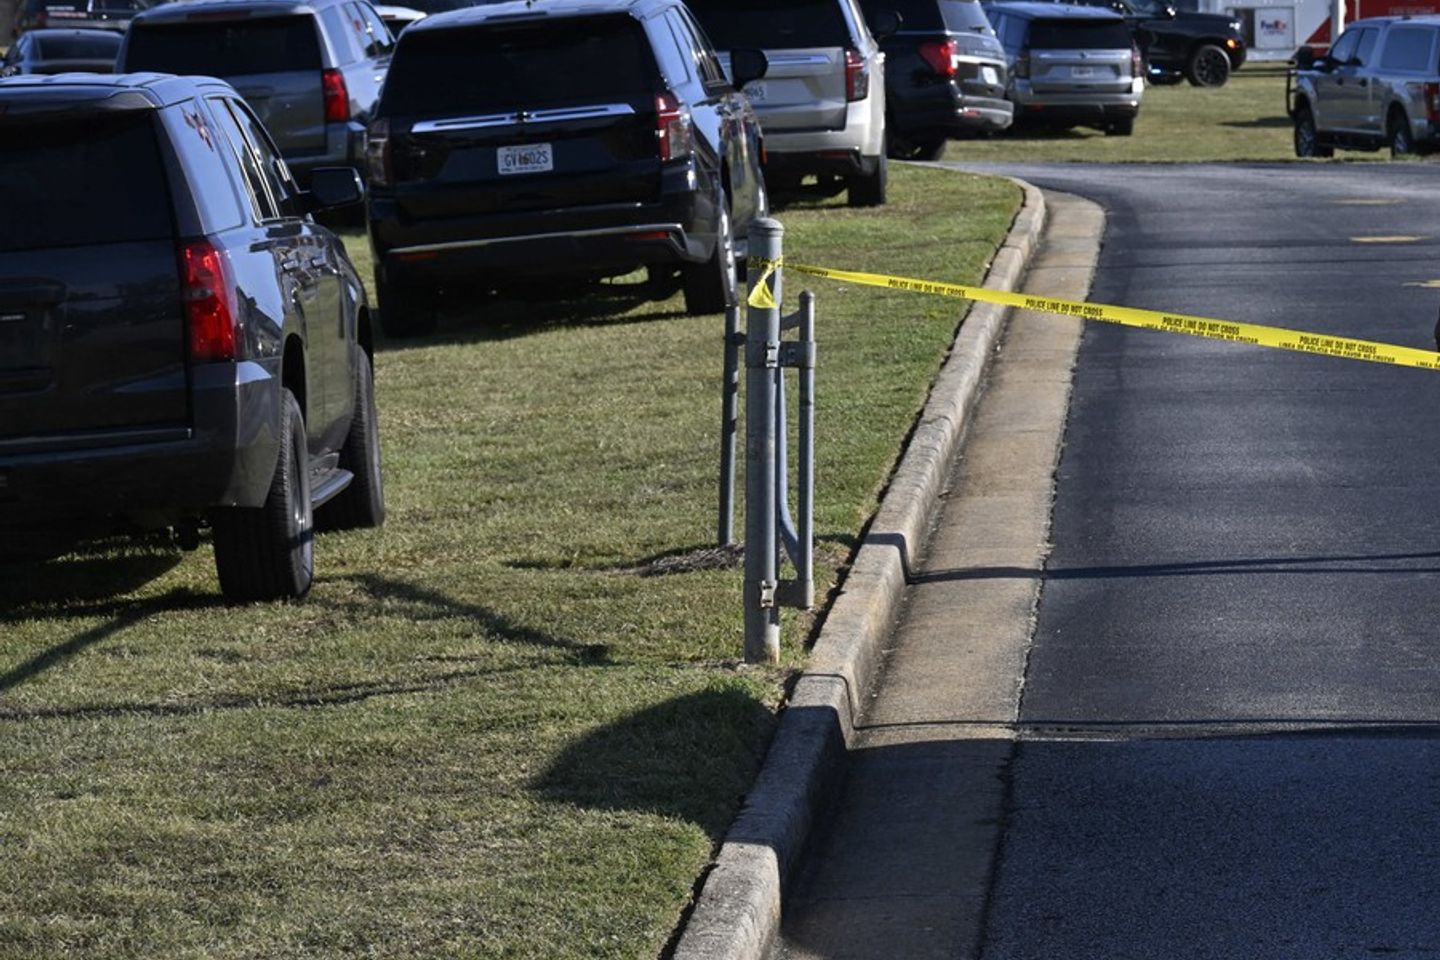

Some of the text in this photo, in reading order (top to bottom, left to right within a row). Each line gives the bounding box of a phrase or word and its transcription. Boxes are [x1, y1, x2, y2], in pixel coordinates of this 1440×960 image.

[888, 278, 908, 288] POLICE
[947, 288, 966, 297] CROSS
[1026, 298, 1103, 316] POLICE LINE DO NOT CROSS
[1162, 316, 1240, 336] POLICE LINE DO NOT CROSS
[1300, 336, 1377, 354] POLICE LINE DO NOT CROSS
